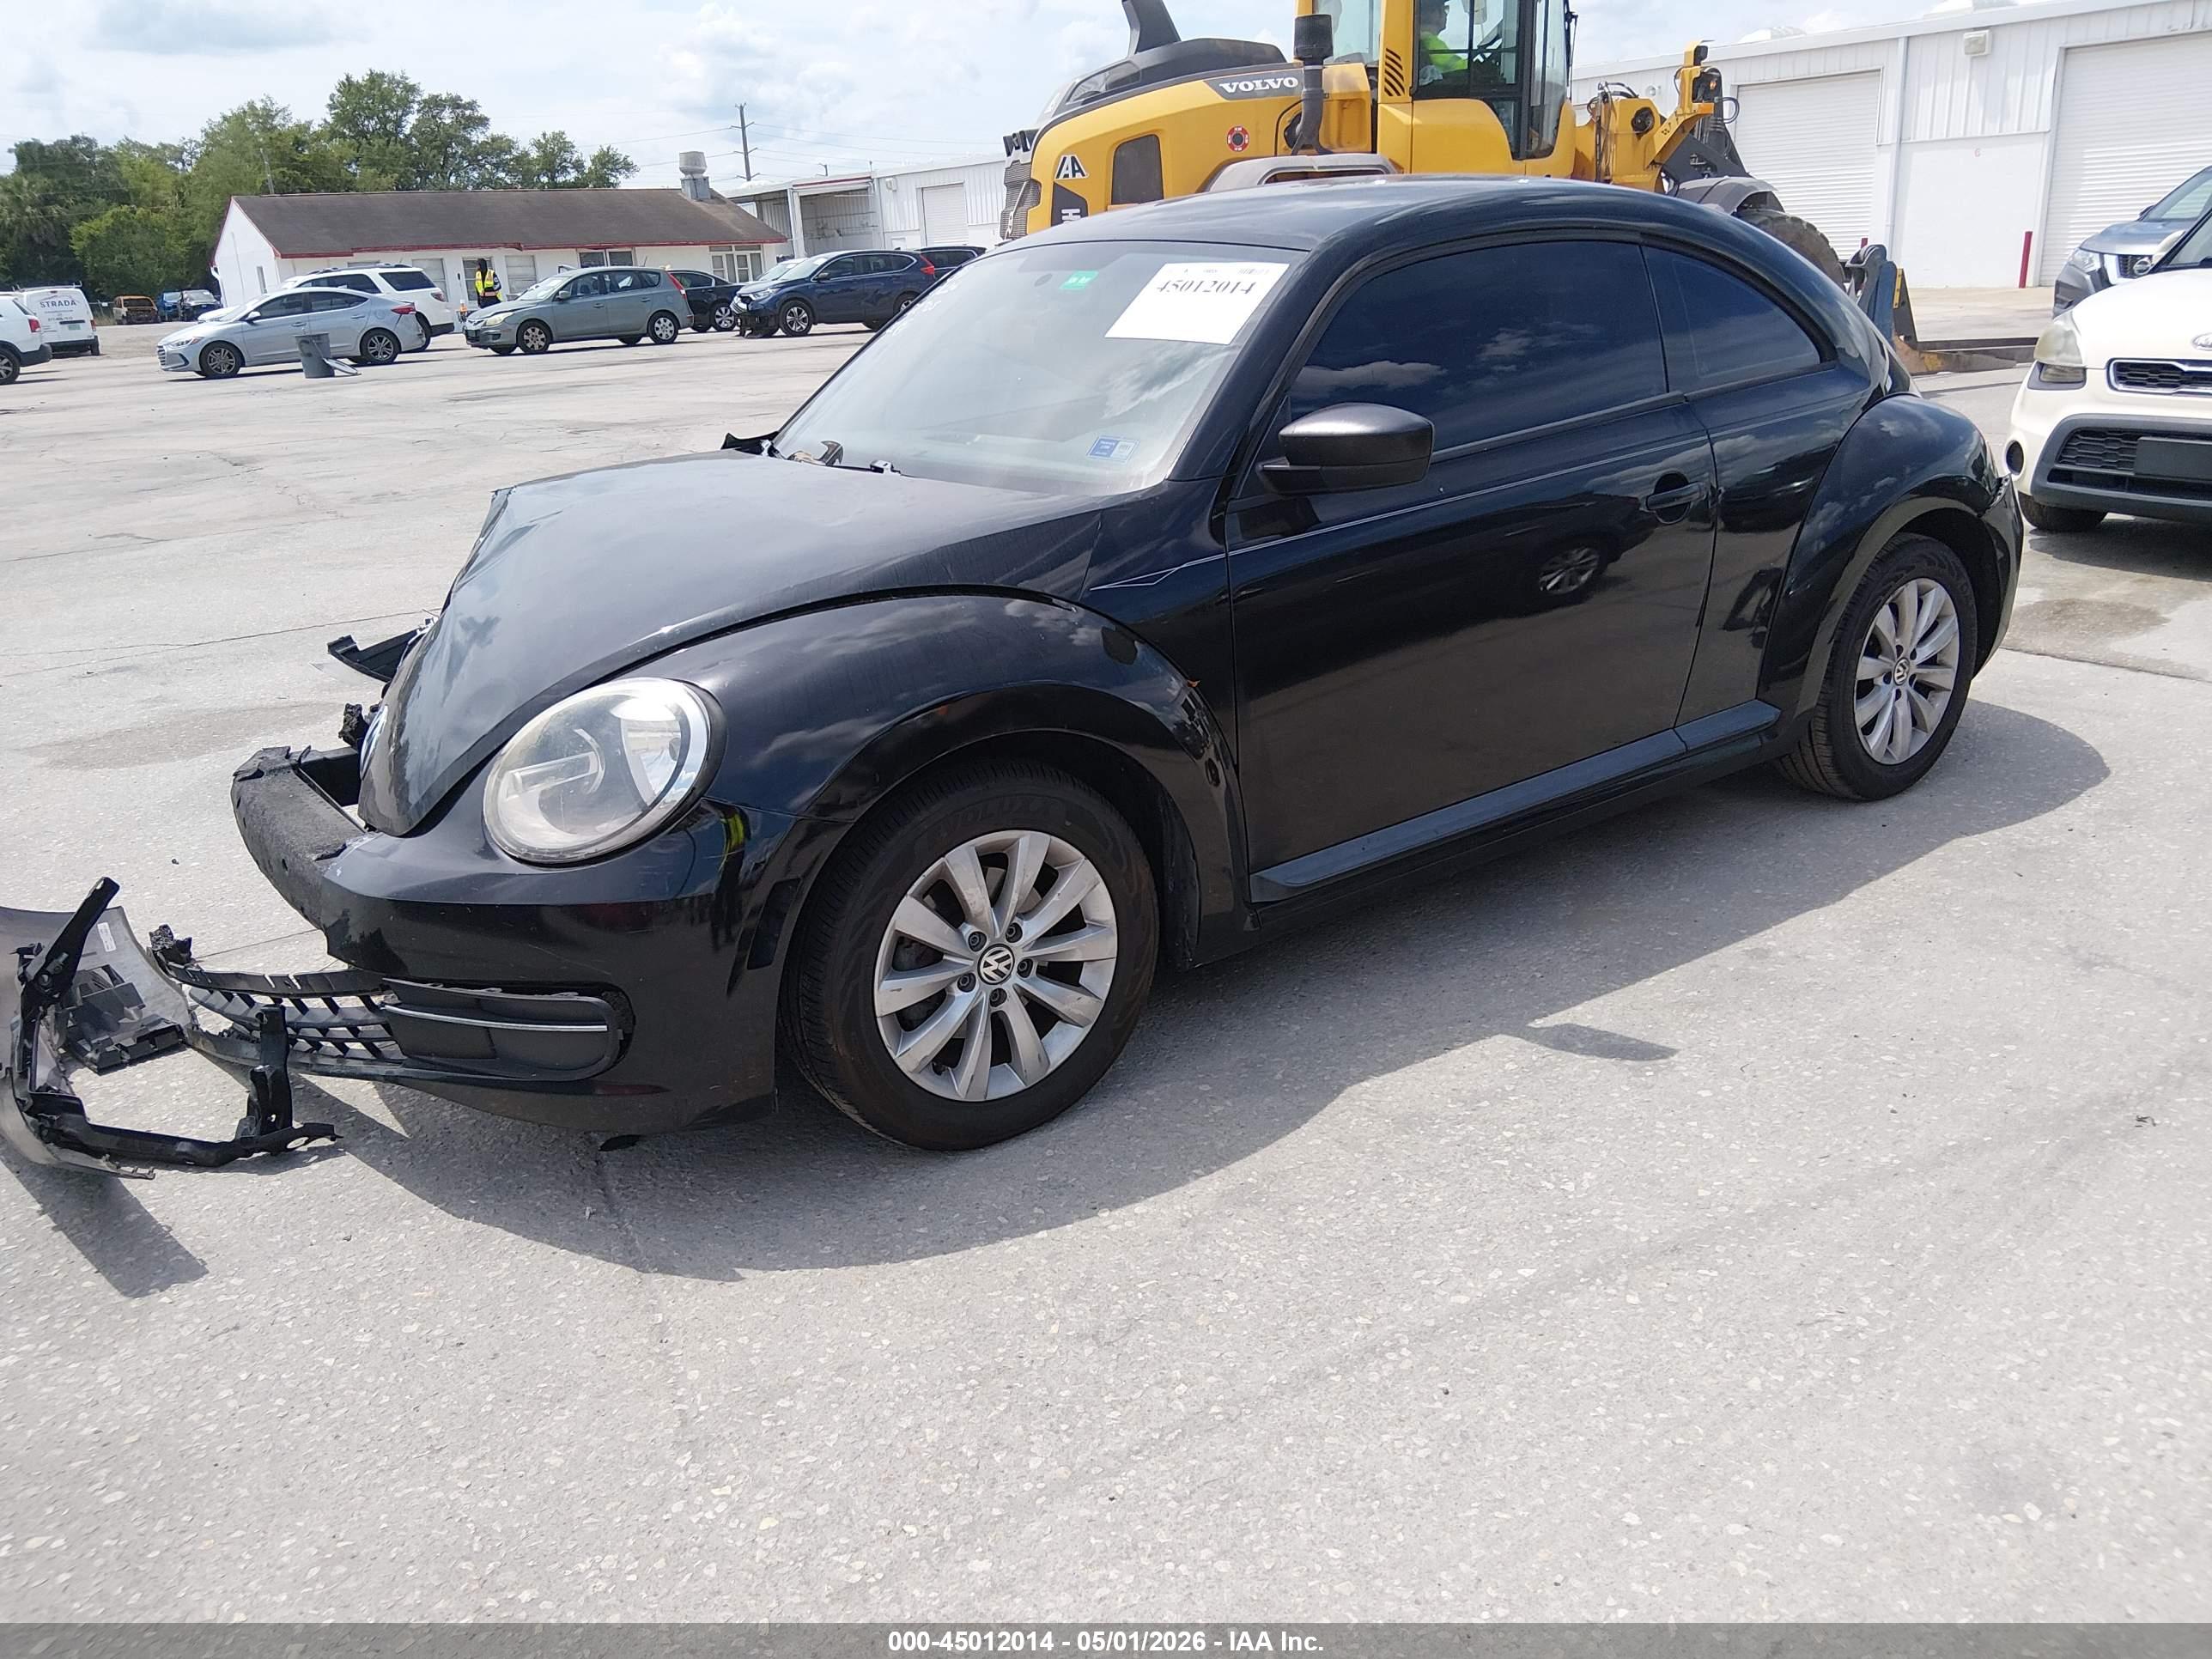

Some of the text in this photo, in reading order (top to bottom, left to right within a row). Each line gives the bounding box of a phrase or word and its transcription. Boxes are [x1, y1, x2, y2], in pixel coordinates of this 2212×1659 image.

[1219, 76, 1298, 94] VOLVO
[1157, 280, 1256, 294] 45012014
[40, 300, 77, 308] STRADA
